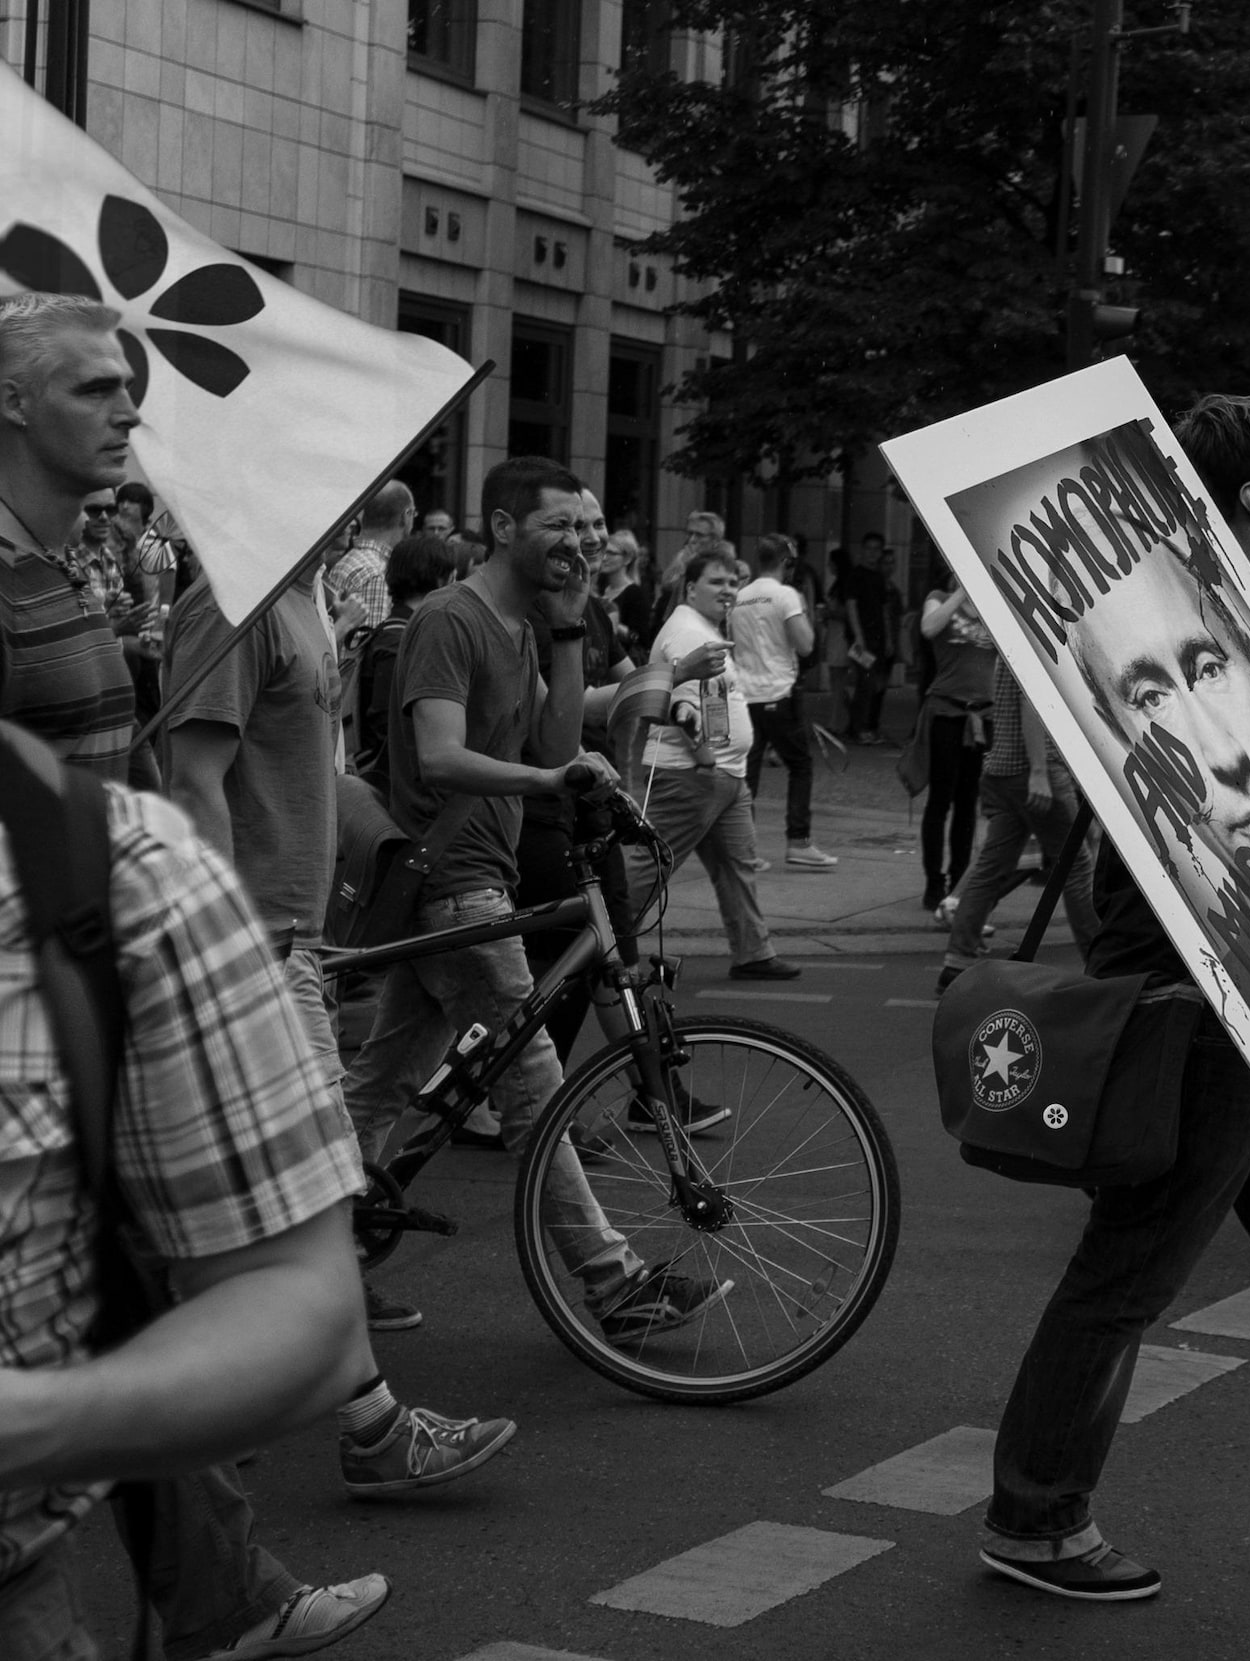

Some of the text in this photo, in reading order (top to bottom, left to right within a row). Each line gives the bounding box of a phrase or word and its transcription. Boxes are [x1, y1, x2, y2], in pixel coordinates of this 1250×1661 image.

[1123, 722, 1207, 862] AND
[979, 1017, 1034, 1054] CONVERSE
[973, 1074, 1020, 1102] ALL STAR
[661, 1119, 678, 1161] SUNTOUR
